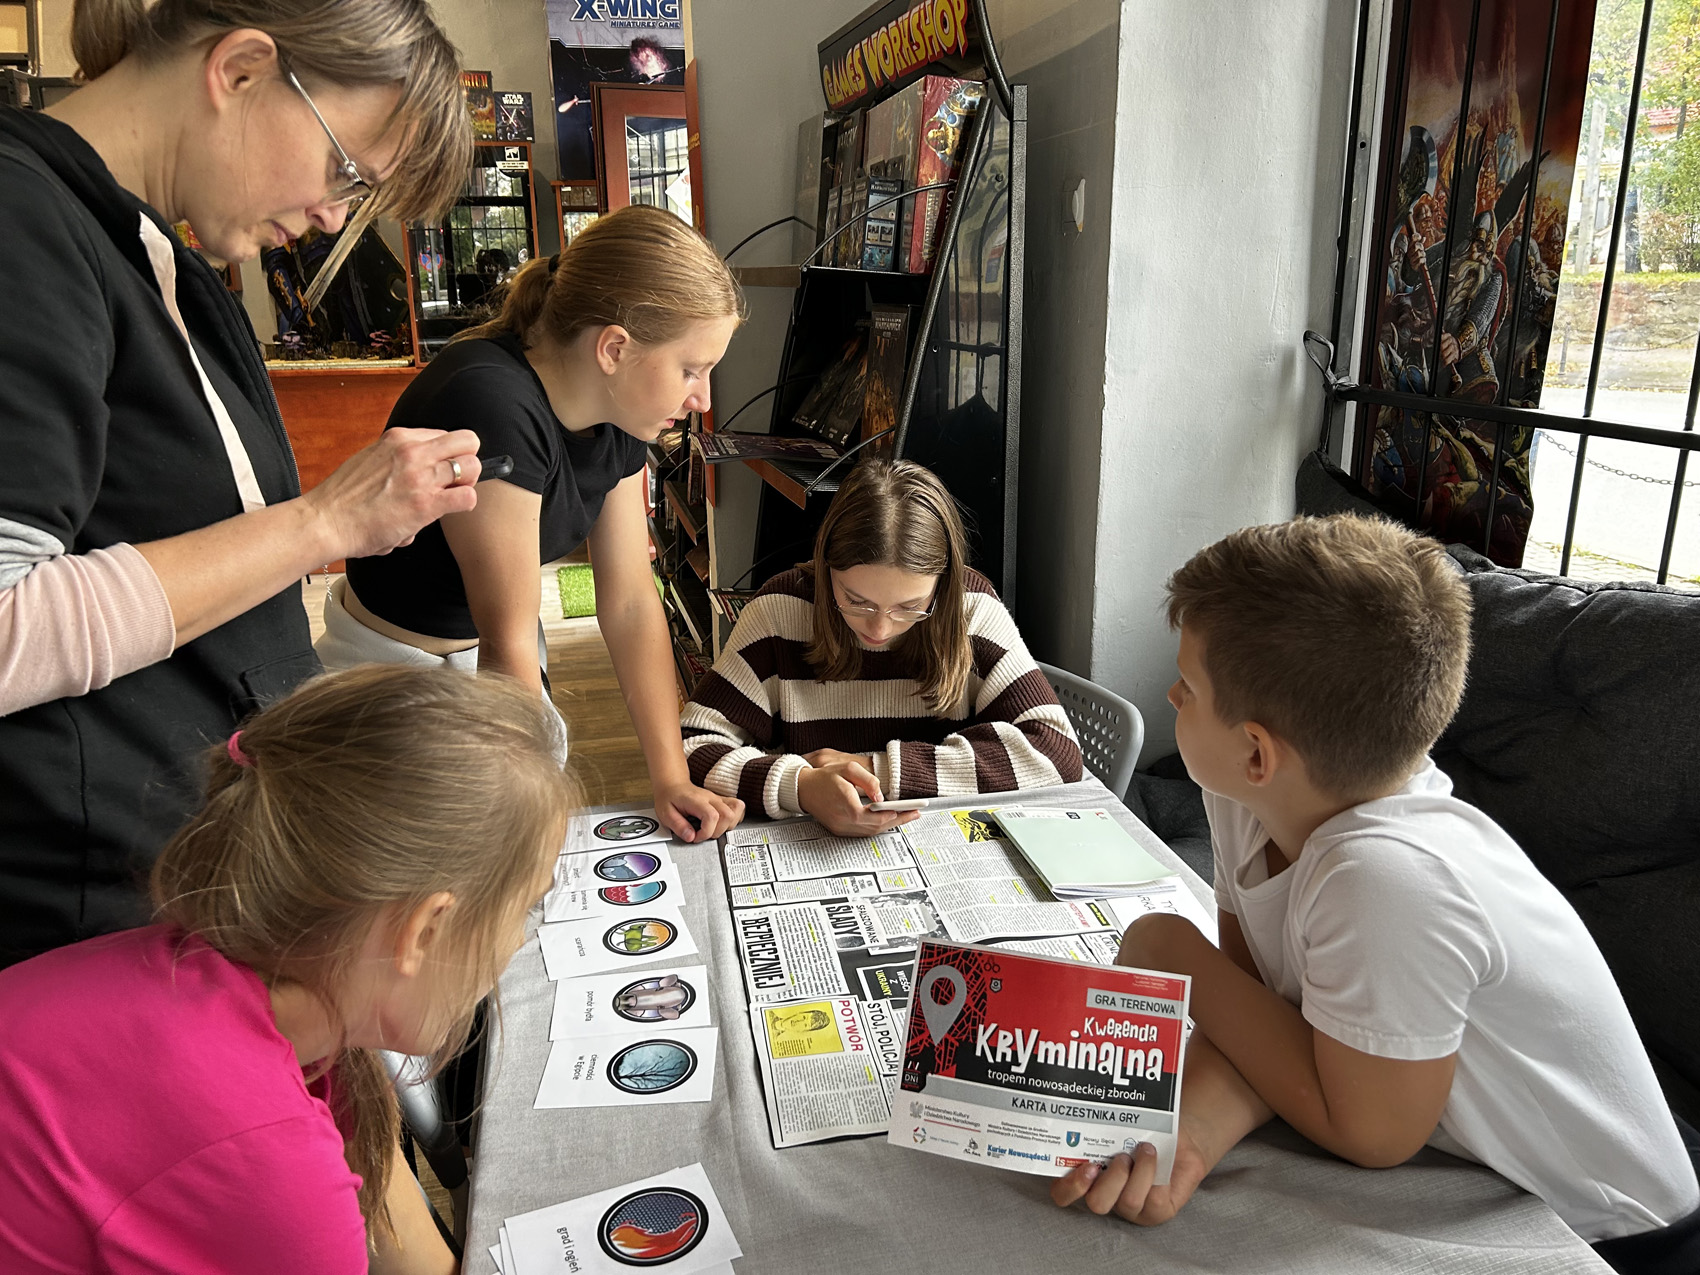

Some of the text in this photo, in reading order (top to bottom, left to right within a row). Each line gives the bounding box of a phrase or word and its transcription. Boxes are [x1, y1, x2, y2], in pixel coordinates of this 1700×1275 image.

[570, 0, 680, 21] X-WING
[610, 20, 681, 29] MINIATURES GAME
[822, 0, 969, 109] GAMES WORKSHOP
[503, 93, 524, 101] STAR
[825, 904, 862, 936] ŚLADY
[741, 916, 786, 990] BEZPIECZNIEJ
[875, 969, 893, 997] UKRAINY
[897, 970, 911, 992] WIEŚCI
[584, 991, 595, 1022] pomór bydła
[867, 1002, 888, 1030] STÓJ,
[1094, 994, 1176, 1015] GRA TERENOWA
[838, 1000, 864, 1052] POTWÓR
[573, 1061, 585, 1080] Egipcie
[586, 1054, 599, 1081] ciemności
[904, 1073, 919, 1083] DNI
[987, 1068, 1147, 1101] tropem nowosądeckiej zbrodni
[1011, 1096, 1140, 1124] KARTA UCZESTNIKA GRY
[987, 1143, 1007, 1154] Kurier
[1008, 1148, 1051, 1161] Nowosądecki
[1056, 1157, 1066, 1167] ts
[557, 1226, 574, 1244] grad
[564, 1249, 582, 1273] ogień
